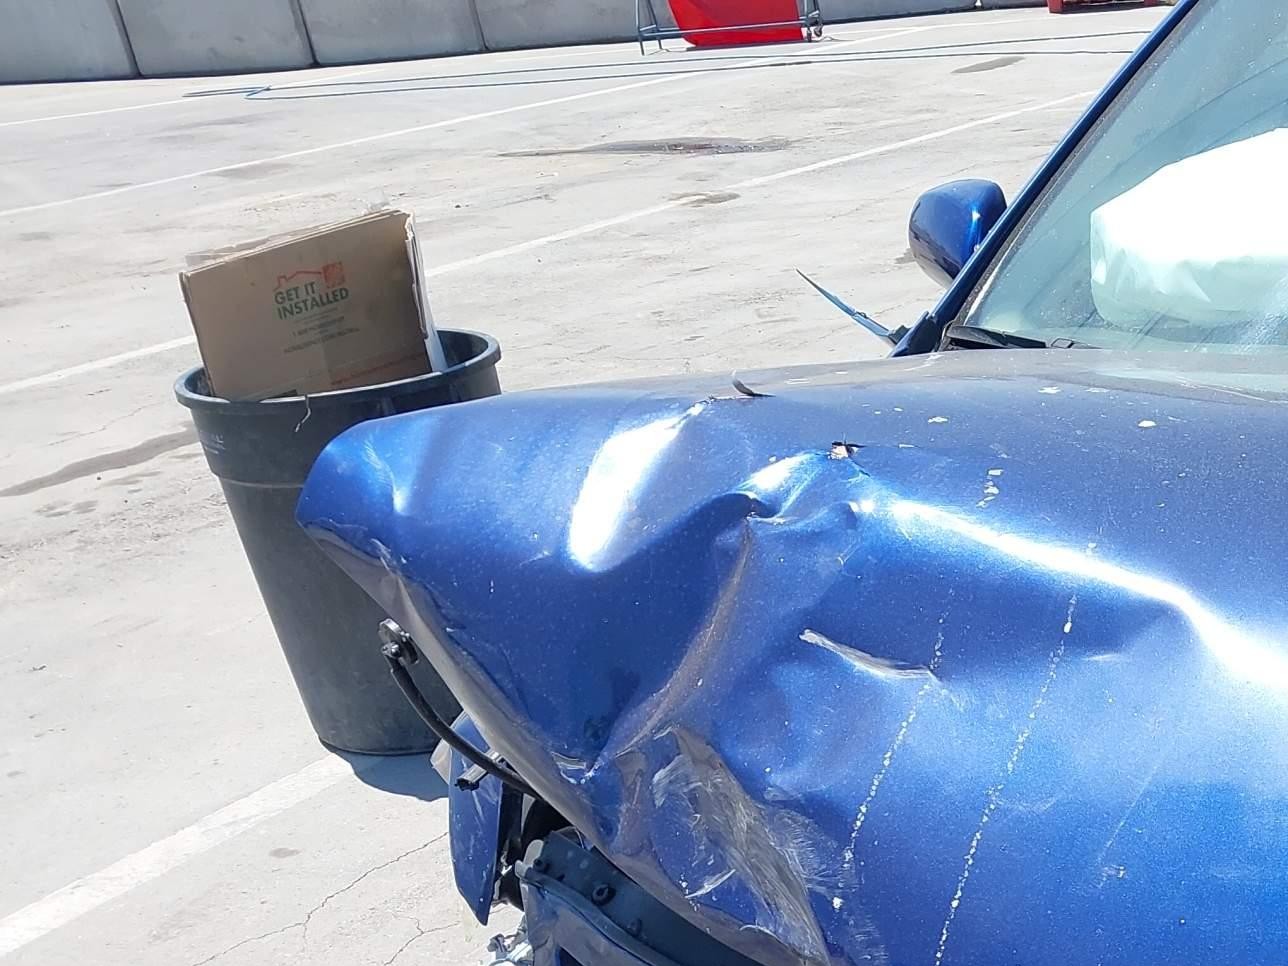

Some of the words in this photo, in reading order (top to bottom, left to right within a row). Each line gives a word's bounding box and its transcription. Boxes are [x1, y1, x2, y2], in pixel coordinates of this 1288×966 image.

[274, 286, 300, 304] GET
[304, 281, 316, 296] IT
[277, 287, 349, 320] INSTALLED
